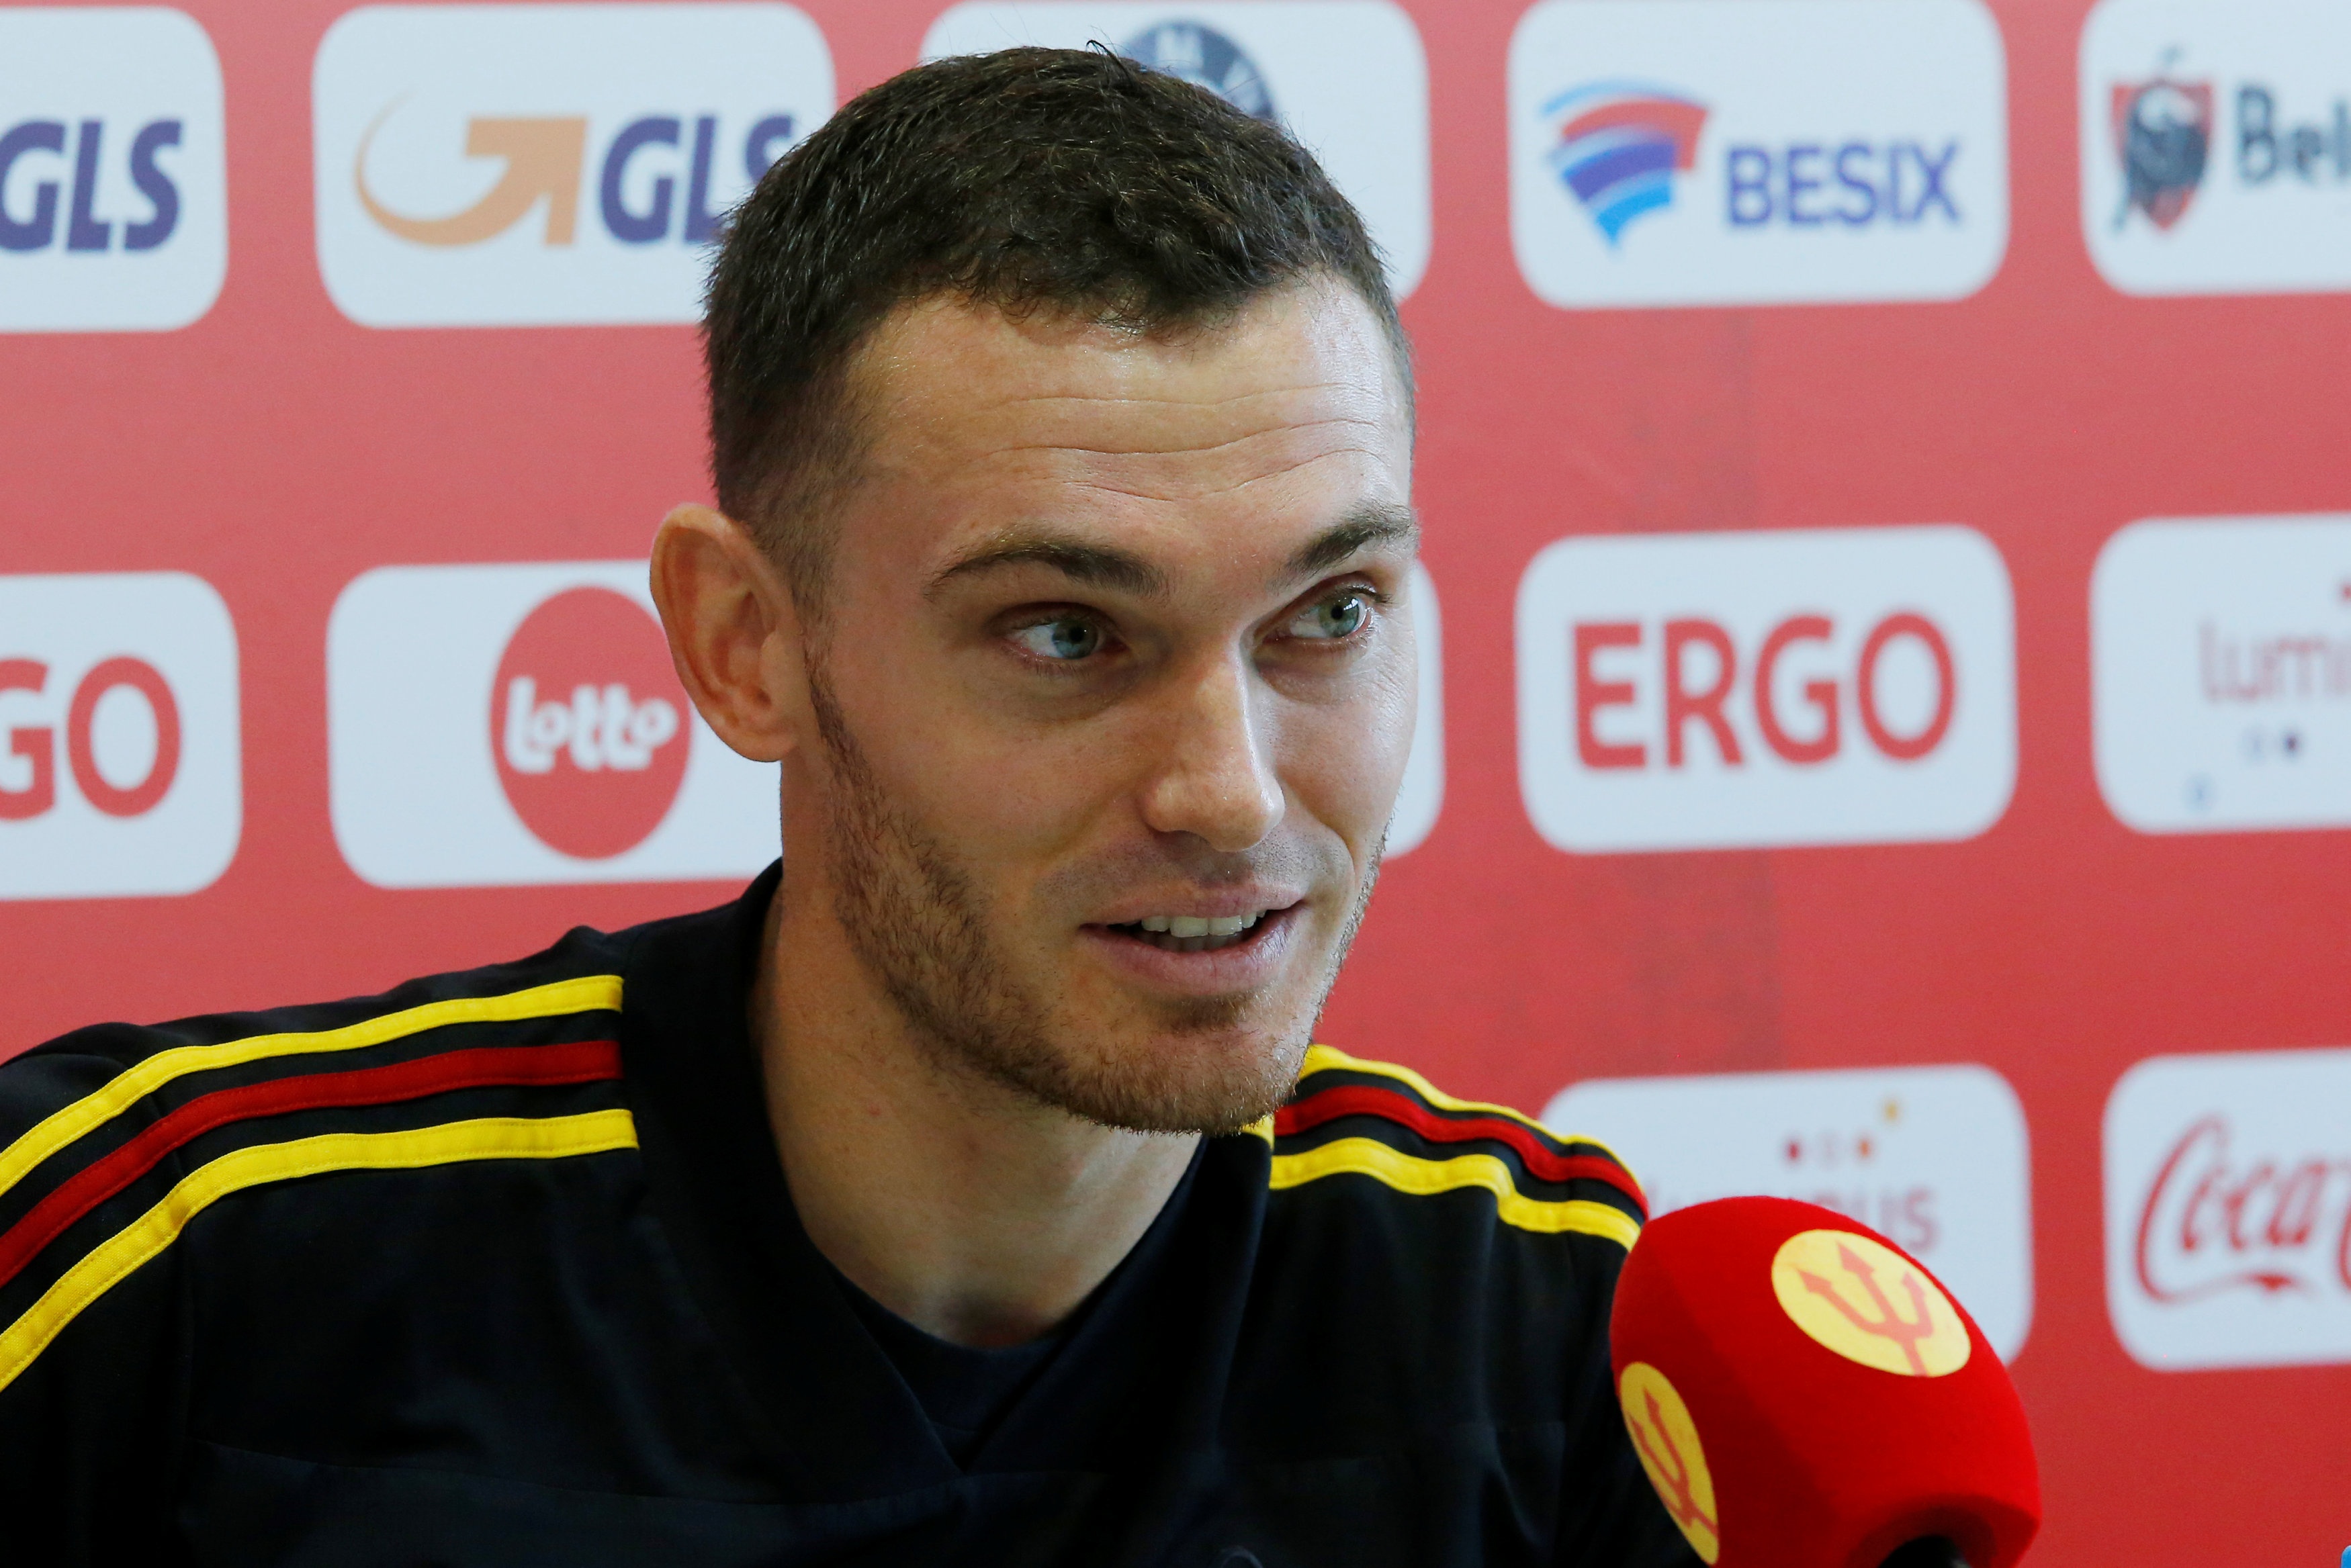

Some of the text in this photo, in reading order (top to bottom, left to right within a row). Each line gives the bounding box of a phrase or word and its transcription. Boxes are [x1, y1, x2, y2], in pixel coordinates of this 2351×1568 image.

[0, 120, 182, 251] GLS
[1725, 141, 1963, 230] BESIX
[1572, 611, 1956, 771] ERGO
